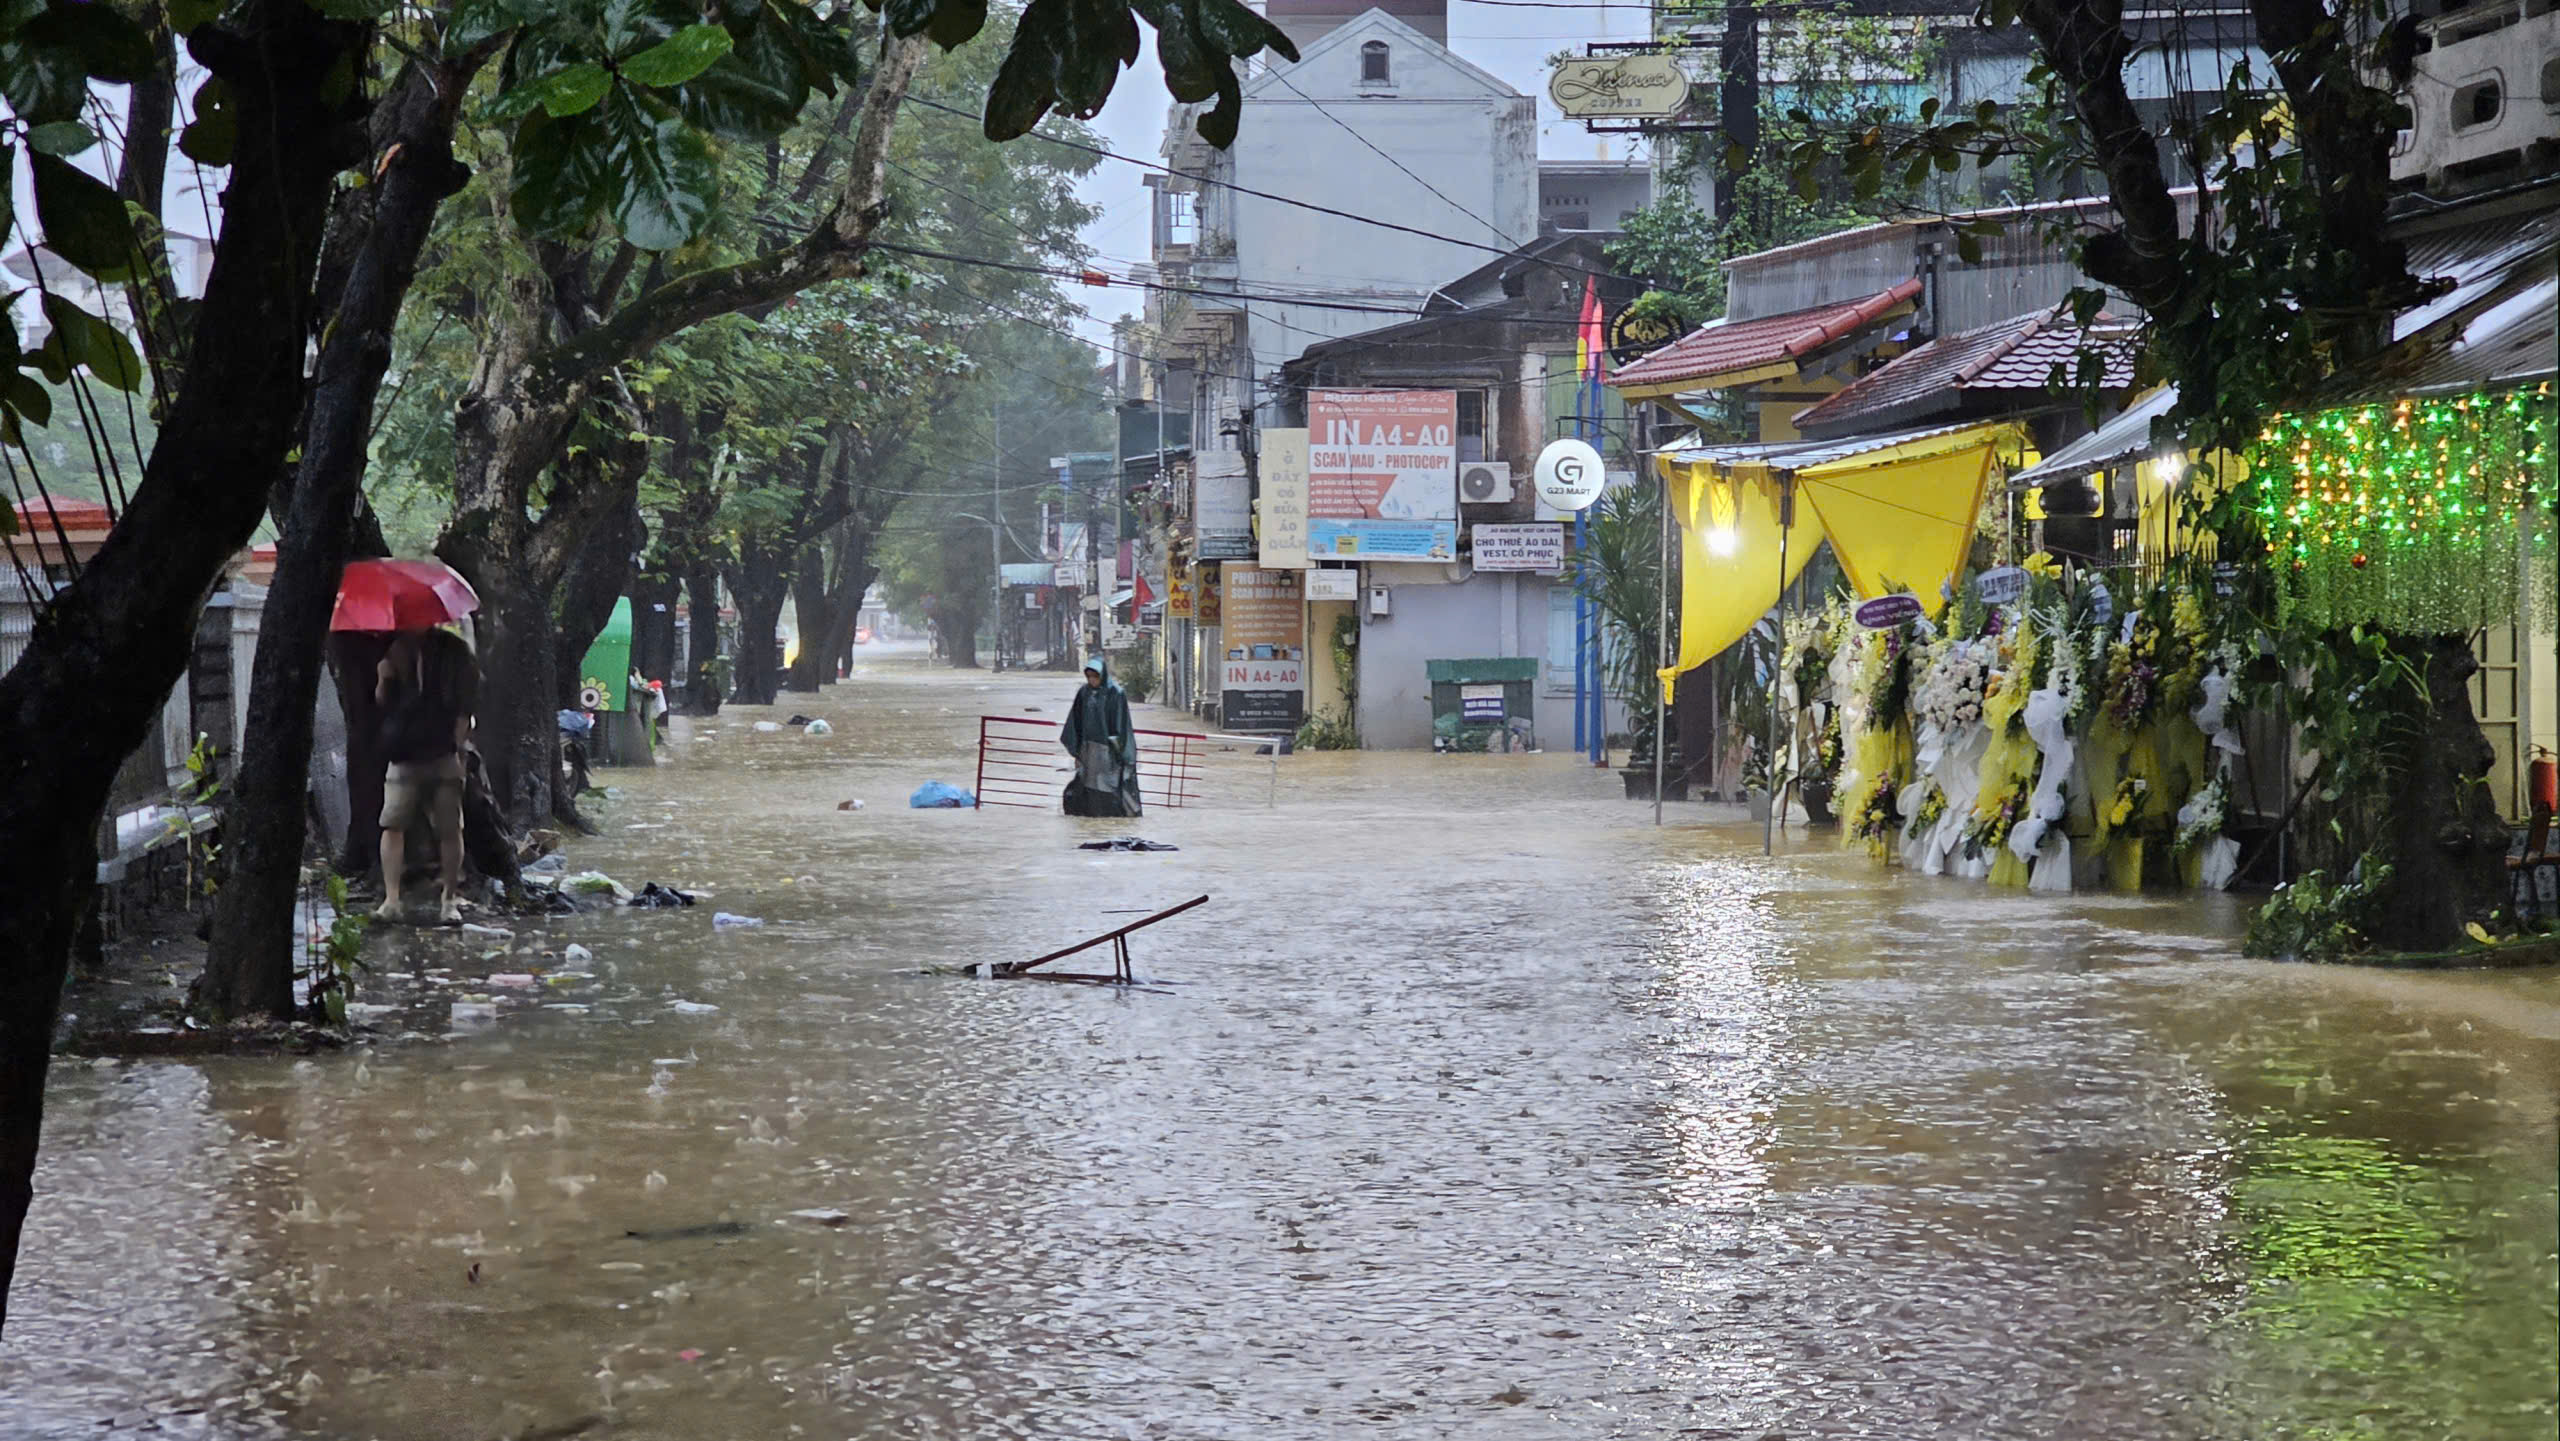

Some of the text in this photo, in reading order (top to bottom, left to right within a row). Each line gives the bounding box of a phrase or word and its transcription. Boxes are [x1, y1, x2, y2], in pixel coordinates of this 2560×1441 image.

[1327, 419, 1360, 445] IN
[1313, 452, 1346, 468] SCAN
[1385, 454, 1450, 469] PHOTOCOPY
[1547, 487, 1592, 496] G23 MART
[1475, 538, 1495, 546] CHO
[1499, 537, 1522, 546] THUÊ
[1525, 538, 1538, 546] ÁO
[1527, 549, 1554, 559] PHỤC
[1228, 667, 1248, 683] IN
